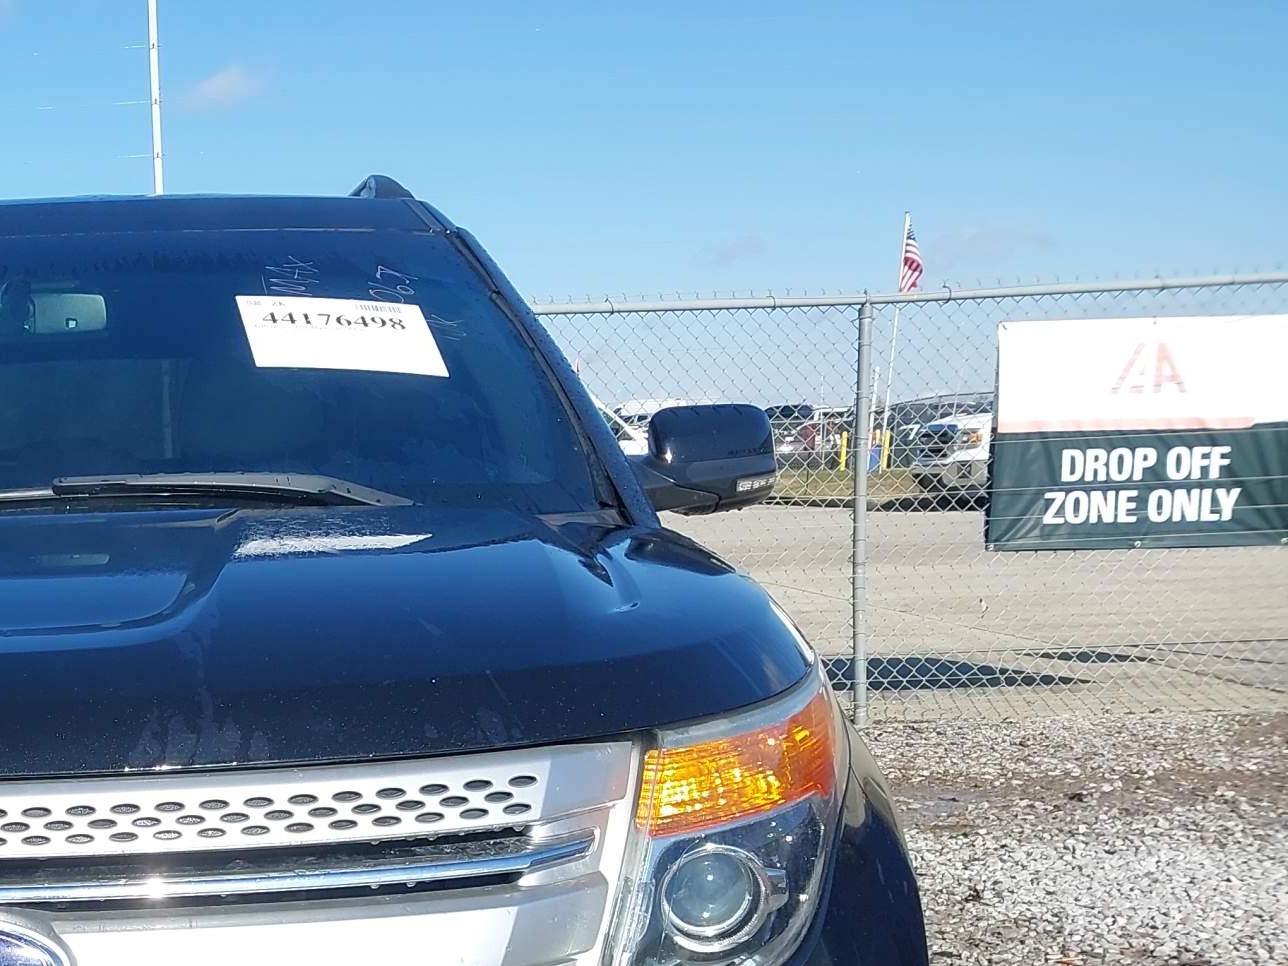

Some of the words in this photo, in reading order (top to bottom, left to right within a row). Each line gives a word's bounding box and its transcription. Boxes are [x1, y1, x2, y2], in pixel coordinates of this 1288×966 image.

[262, 311, 407, 330] 44176498
[1061, 446, 1157, 482] DROP
[1166, 446, 1232, 480] OFF
[1042, 490, 1139, 524] ZONE
[1147, 488, 1242, 522] ONLY
